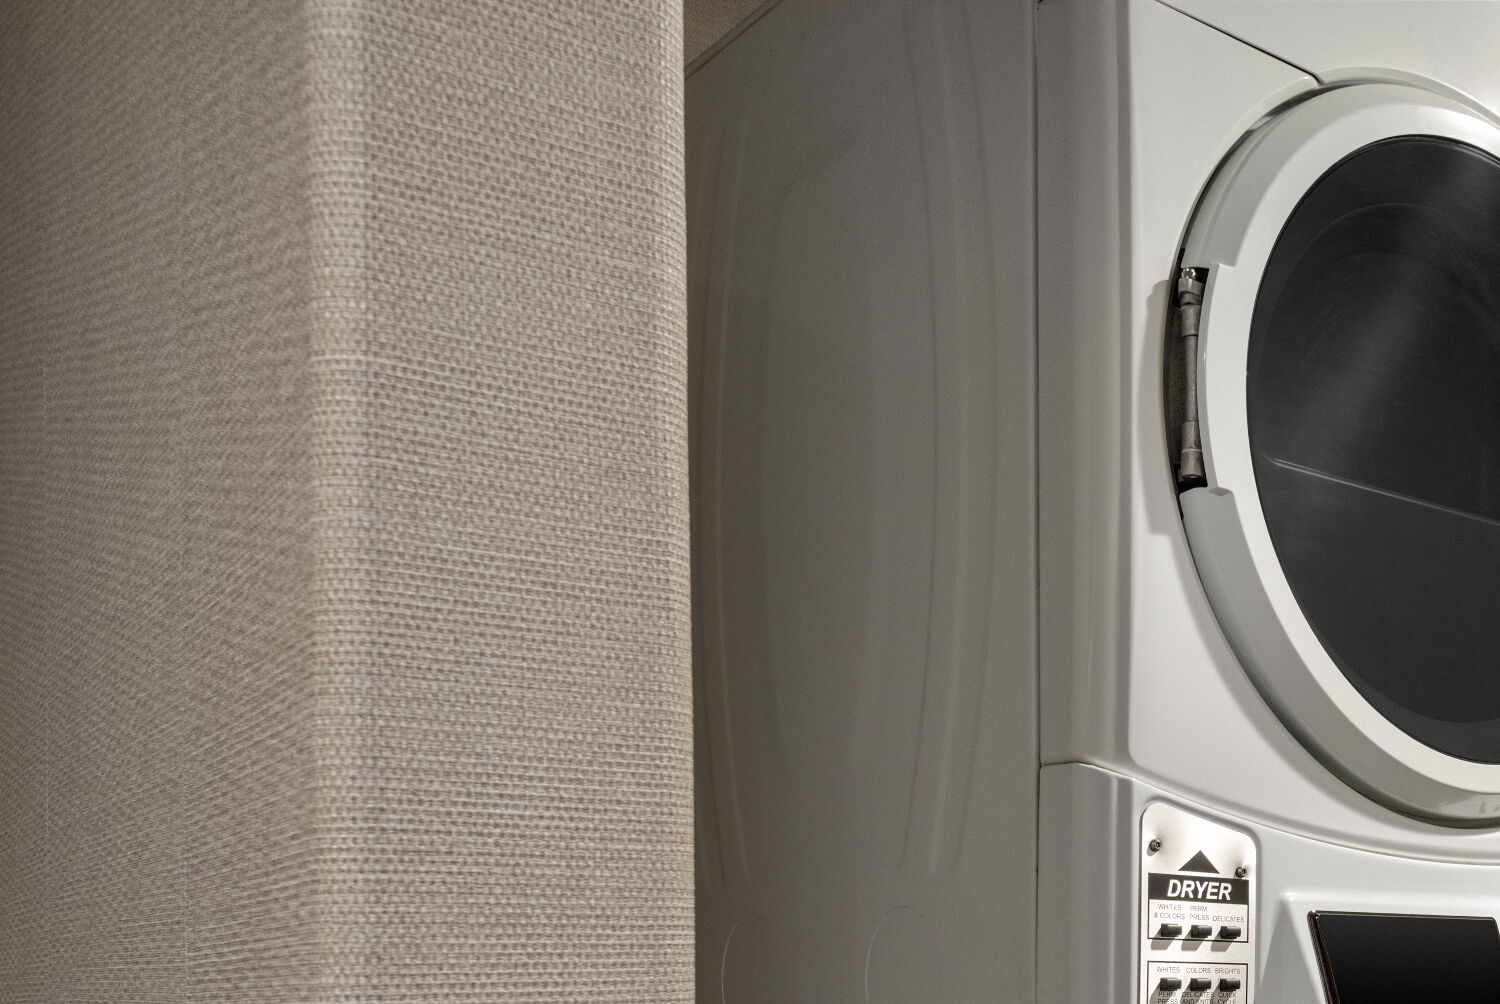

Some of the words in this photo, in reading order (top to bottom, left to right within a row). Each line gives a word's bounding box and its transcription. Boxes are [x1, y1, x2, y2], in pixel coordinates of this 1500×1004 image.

[1167, 879, 1232, 900] DRYER
[1160, 912, 1185, 920] COLORS
[1213, 915, 1245, 923] DELICATES
[1215, 967, 1241, 975] BRIGHTS
